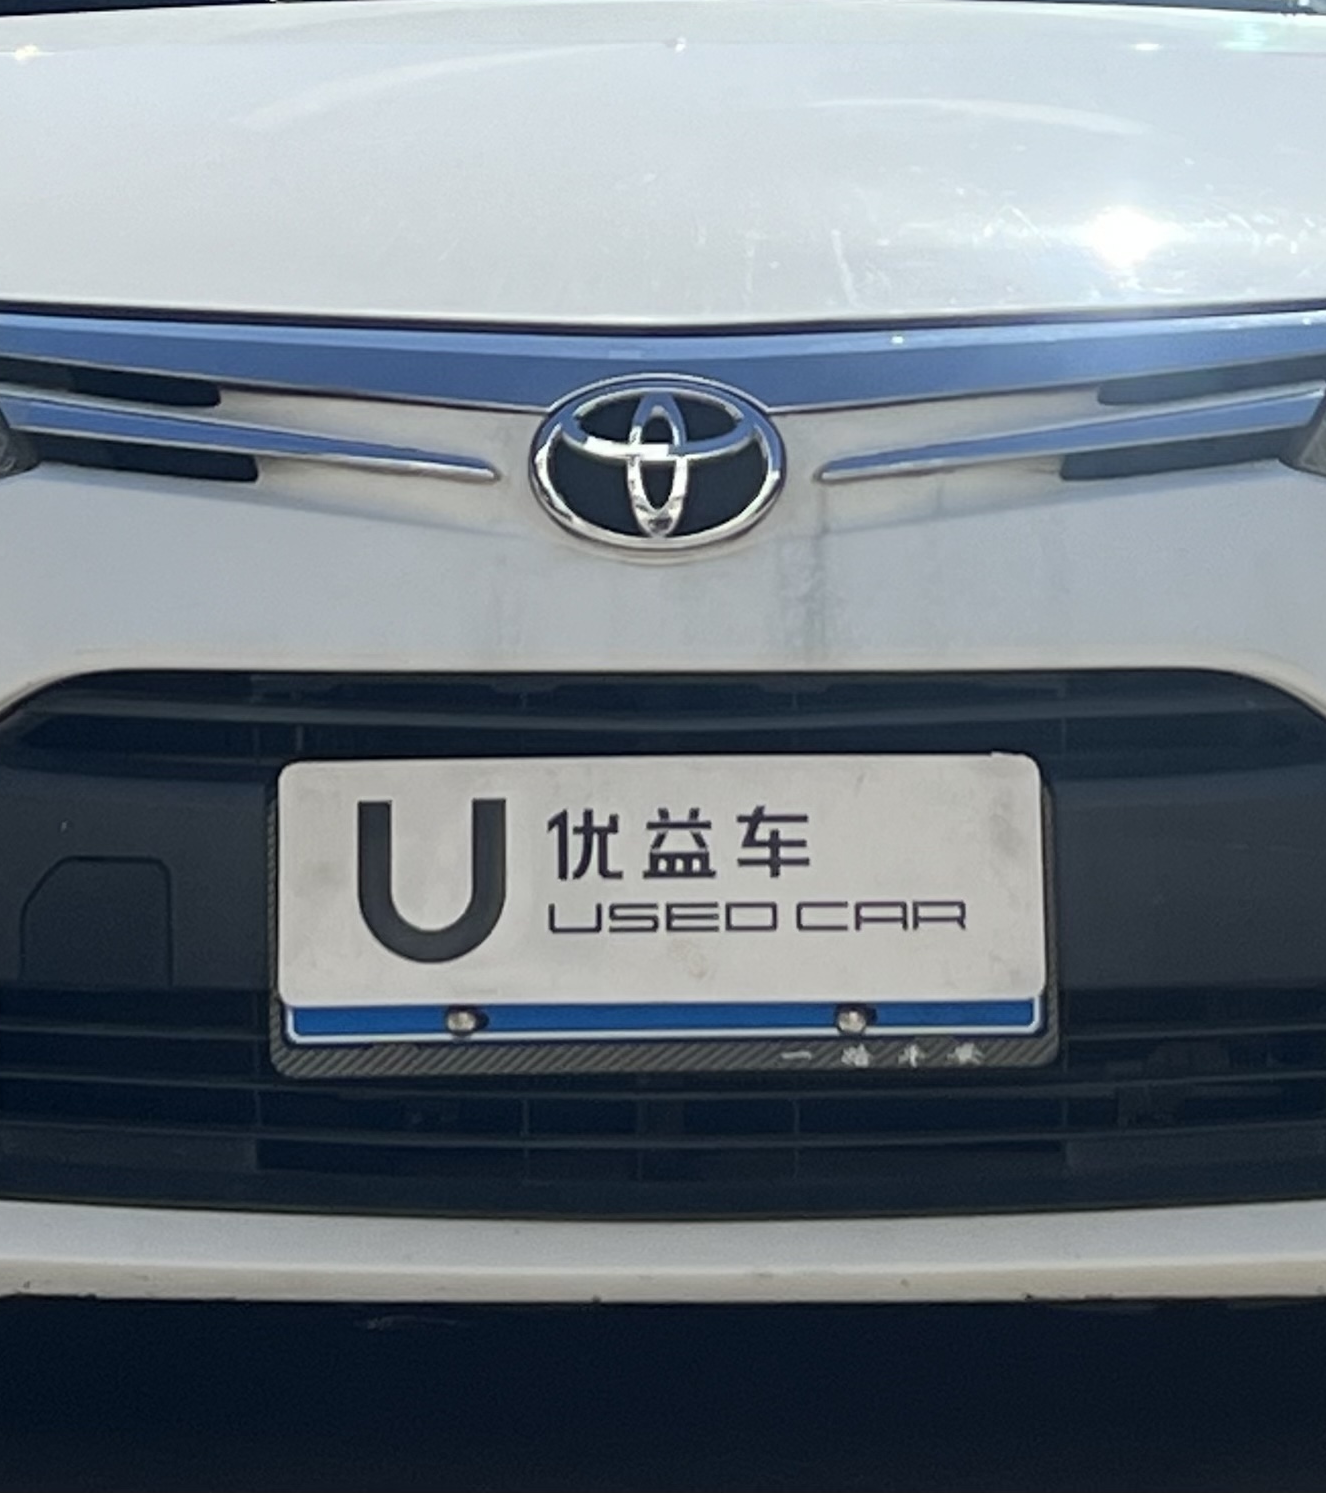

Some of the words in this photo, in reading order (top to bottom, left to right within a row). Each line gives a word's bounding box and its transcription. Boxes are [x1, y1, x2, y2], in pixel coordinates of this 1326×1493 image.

[357, 798, 507, 963] U
[547, 806, 812, 882] 优益车
[548, 902, 778, 935] USED
[796, 901, 968, 933] CAR
